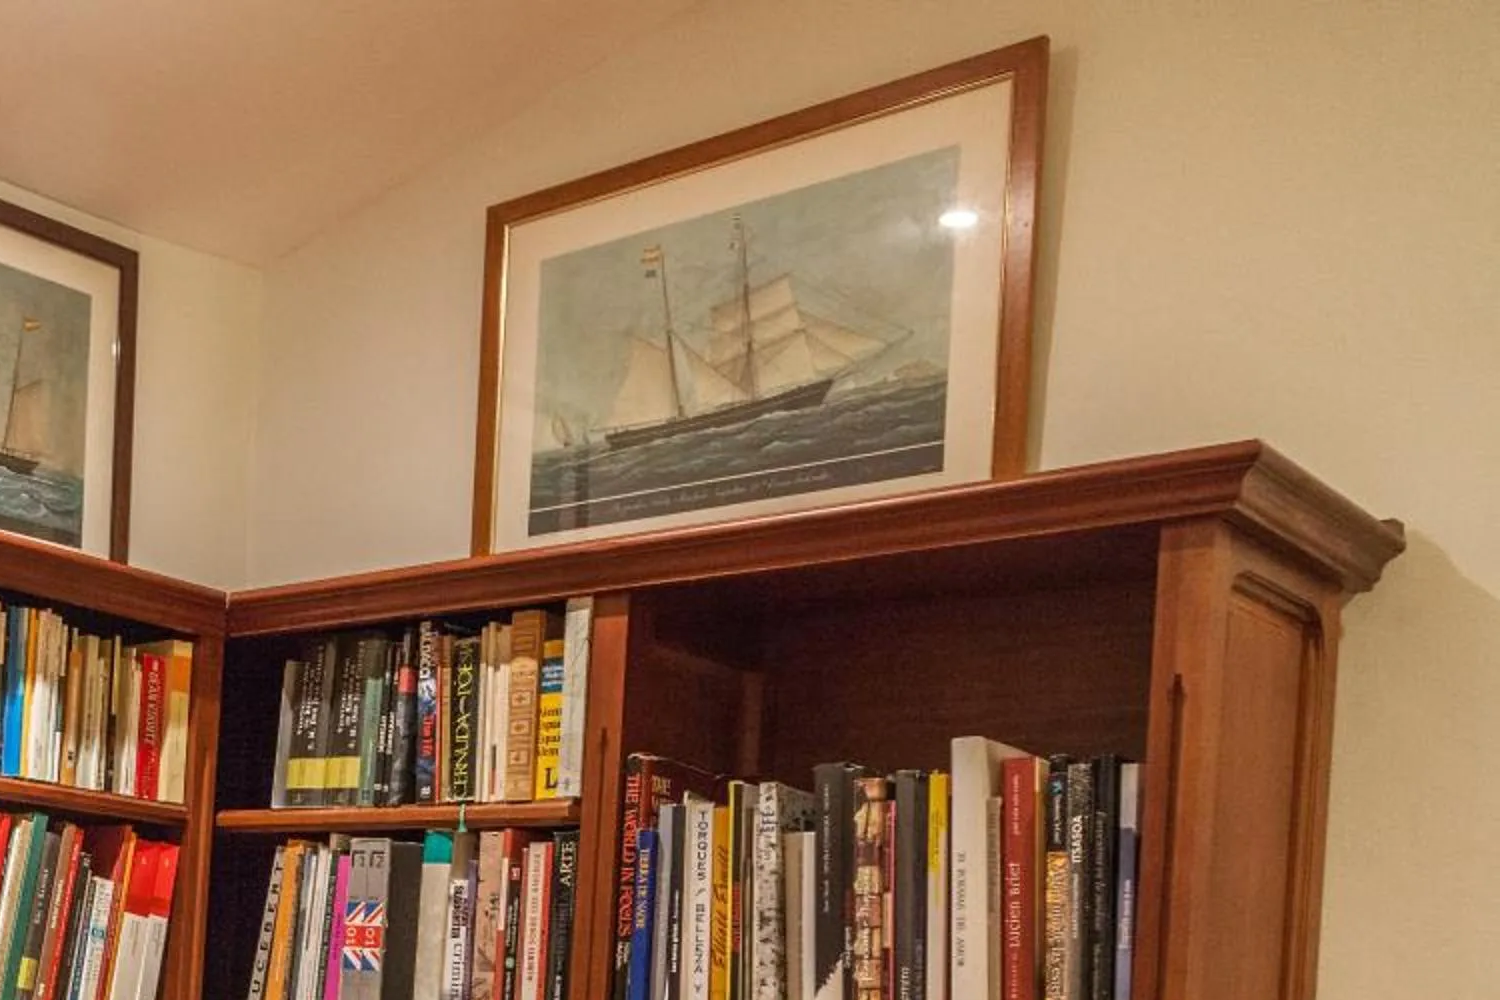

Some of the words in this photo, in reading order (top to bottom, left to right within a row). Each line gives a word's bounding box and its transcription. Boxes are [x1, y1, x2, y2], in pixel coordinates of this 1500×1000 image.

[626, 773, 640, 803] THE
[621, 808, 638, 862] WORLD
[696, 810, 709, 881] TORQUES
[1071, 814, 1083, 864] ITSASOA
[560, 841, 573, 887] ARTE
[620, 866, 634, 882] IN
[617, 886, 633, 937] FOCUS
